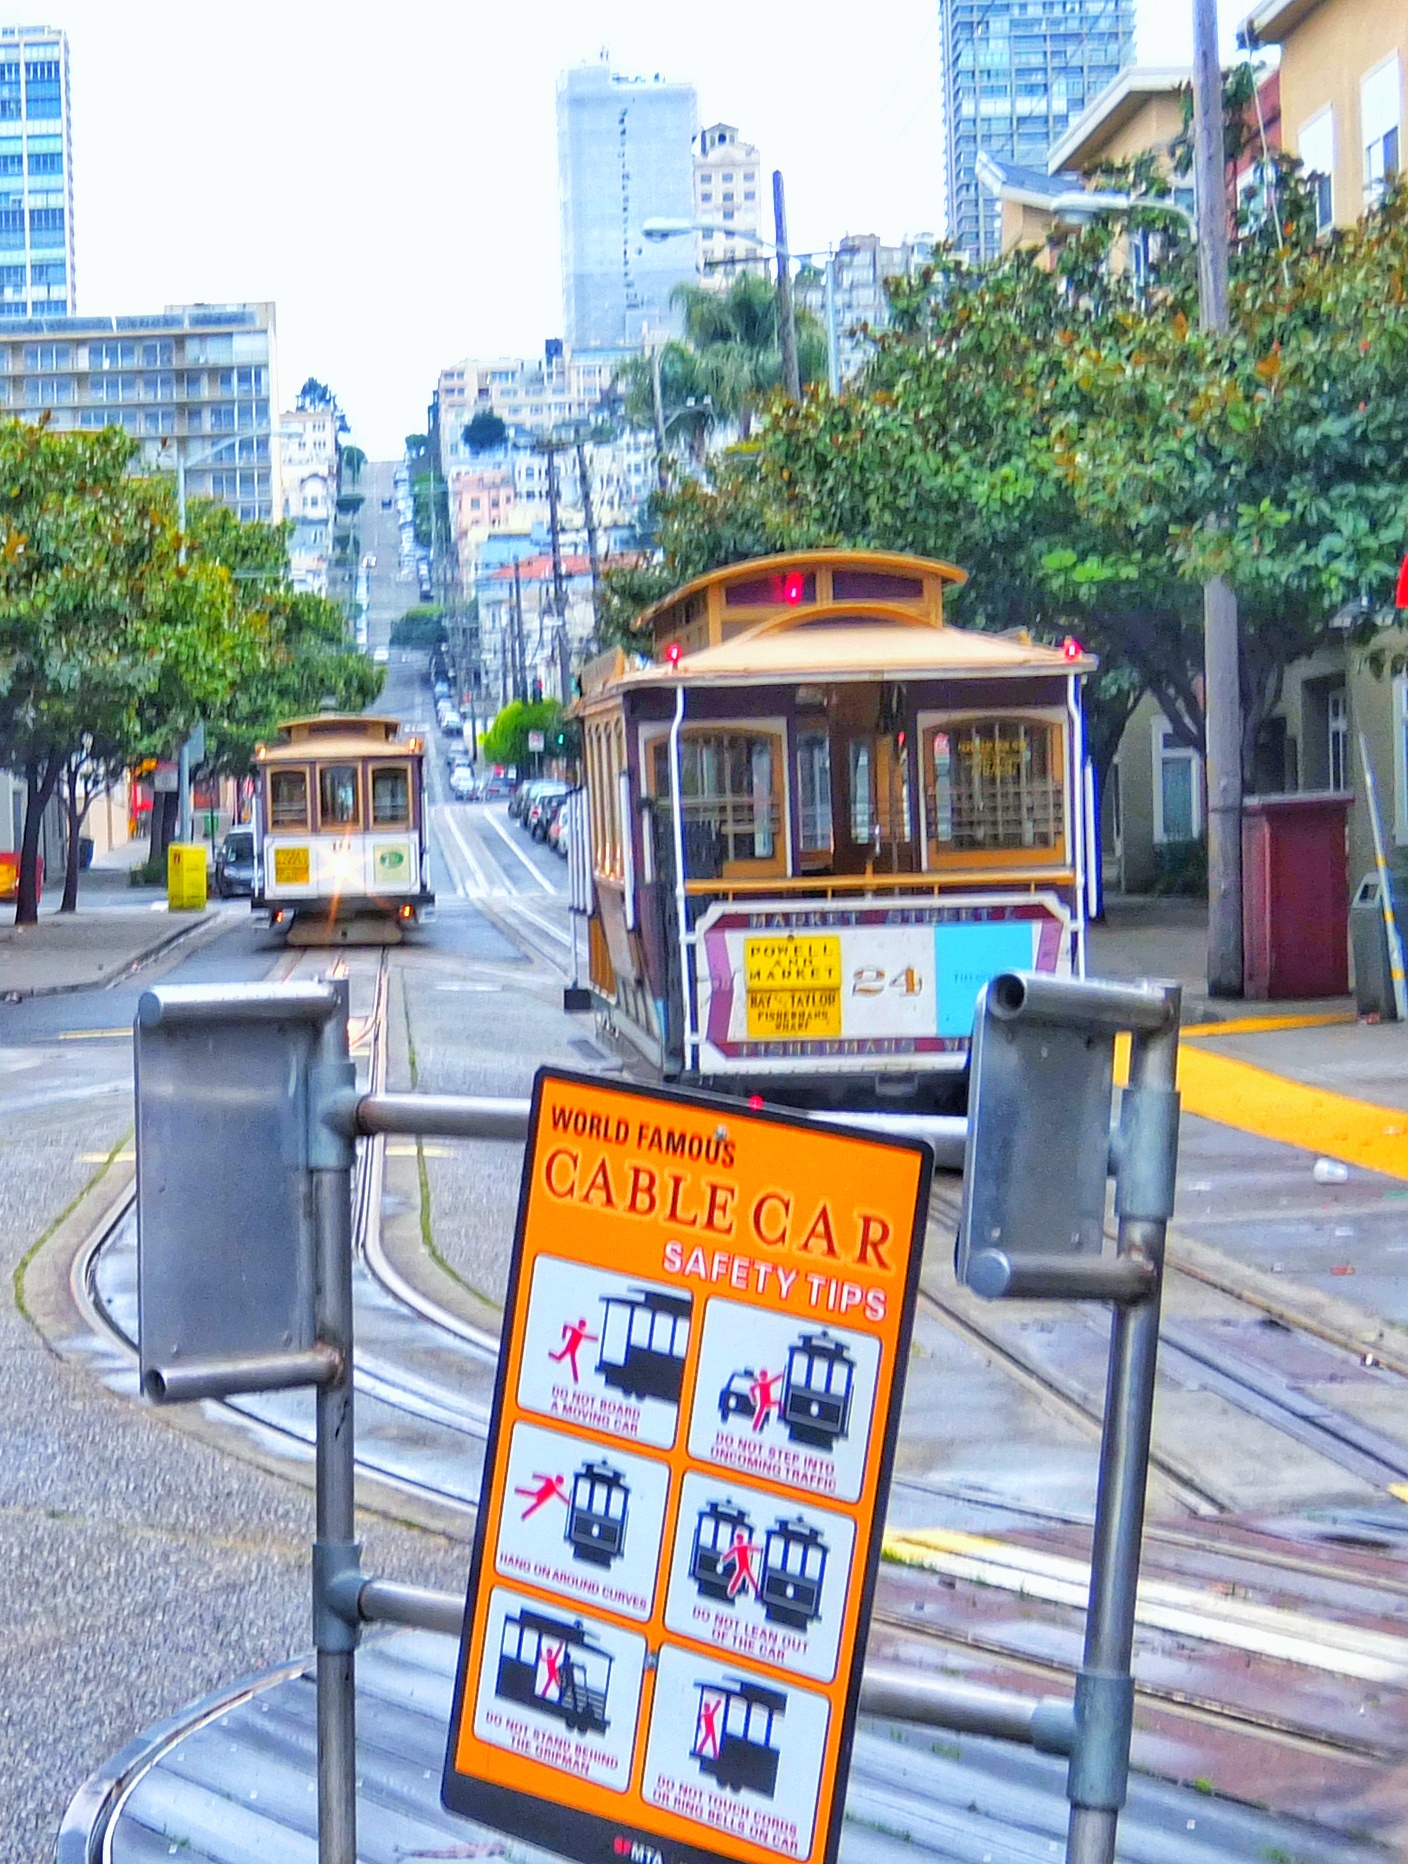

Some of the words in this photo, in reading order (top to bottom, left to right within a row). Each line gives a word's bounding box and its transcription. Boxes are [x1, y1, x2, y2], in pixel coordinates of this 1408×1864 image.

[750, 910, 857, 928] MARKET
[750, 944, 833, 958] POWELL
[774, 957, 813, 968] AND
[750, 968, 832, 981] MARKET
[852, 965, 923, 998] 24
[750, 991, 771, 1008] BAY
[791, 991, 836, 1008] TAYLOR
[551, 1105, 630, 1146] WORLD
[638, 1123, 737, 1168] FAMOUS
[544, 1148, 736, 1236] CABLE
[752, 1191, 891, 1270] CAR
[663, 1240, 797, 1300] SAFETY
[806, 1273, 888, 1322] TIPS
[550, 1401, 558, 1414] A
[562, 1402, 610, 1429] MOVING
[614, 1418, 638, 1436] CAR
[552, 1384, 568, 1400] DO
[572, 1390, 595, 1408] NOT
[599, 1398, 640, 1421] BOARD
[710, 1446, 781, 1478] ONCOMING
[786, 1467, 837, 1493] TRAFFIC
[715, 1431, 734, 1447] DO
[738, 1437, 763, 1456] NOT
[768, 1447, 800, 1465] STEP
[803, 1456, 835, 1475] INTO
[534, 1563, 551, 1580] ON
[552, 1568, 600, 1595] AROUND
[601, 1586, 648, 1611] CURVES
[692, 1605, 710, 1622] DO
[714, 1613, 739, 1633] NOT
[744, 1622, 779, 1645] LEAN
[782, 1635, 809, 1656] OUT
[712, 1628, 728, 1645] OF
[732, 1634, 755, 1653] THE
[759, 1644, 785, 1664] CAR
[485, 1711, 502, 1728] DO
[505, 1717, 528, 1736] NOT
[533, 1728, 572, 1753] STAND
[574, 1742, 619, 1770] BEHIND
[511, 1735, 530, 1753] THE
[534, 1745, 590, 1776] GRIPMAN
[652, 1789, 670, 1806] OR
[673, 1796, 704, 1819] RING
[707, 1808, 745, 1834] BELLS
[749, 1825, 768, 1844] ON
[772, 1833, 798, 1854] CAR
[657, 1775, 675, 1791] DO
[678, 1783, 704, 1803] NOT
[707, 1793, 750, 1818] TOUCH
[753, 1809, 798, 1836] CORDS
